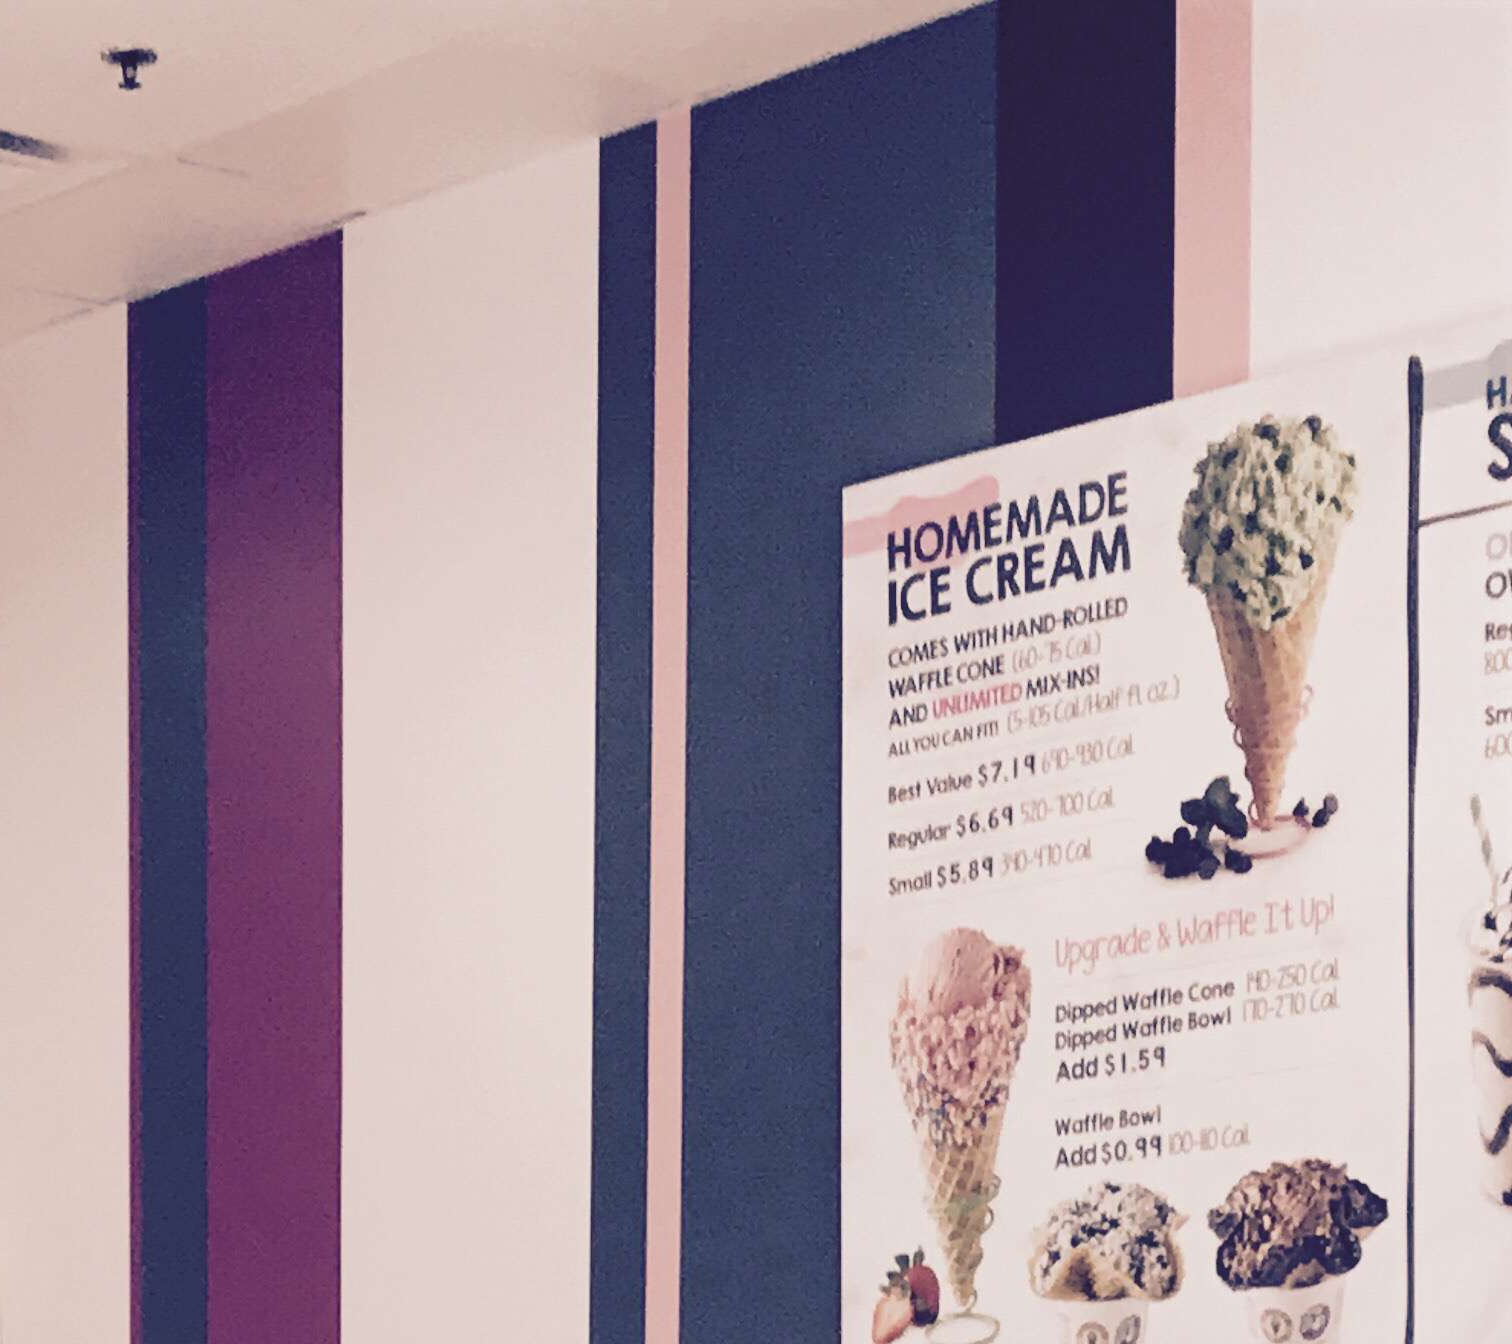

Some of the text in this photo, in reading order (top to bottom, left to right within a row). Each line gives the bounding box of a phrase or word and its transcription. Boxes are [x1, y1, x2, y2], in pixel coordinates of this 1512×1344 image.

[887, 471, 1128, 571] HOMEMADE
[888, 524, 1131, 626] ICE CREAM
[888, 597, 1129, 668] COMES WITH HAND-ROLLED
[888, 670, 952, 699] WAFFLE
[957, 655, 1005, 683] CONE
[888, 663, 1101, 729] AND UNLIMITED MIX-INS!
[888, 741, 910, 758] ALL
[913, 735, 938, 754] YOU
[942, 724, 973, 745] CAN
[888, 779, 921, 806] Best
[926, 770, 973, 797] Value
[978, 754, 1036, 790] $7.19
[1107, 732, 1134, 760] Cal
[888, 822, 952, 850] Regular
[956, 805, 1014, 838] $6.69
[1088, 785, 1114, 811] Cal
[888, 870, 932, 896] Small
[936, 855, 994, 889] $5.89
[1066, 836, 1092, 862] Cal
[1055, 894, 1335, 976] Upgrade & Waffle It Up!
[1055, 995, 1118, 1024] Dipped
[1122, 986, 1183, 1012] Waffle
[1188, 981, 1236, 1002] Cone
[1311, 958, 1339, 984] Cal
[1055, 1022, 1118, 1051] Dipped
[1122, 1012, 1183, 1039] Waffle
[1188, 1006, 1233, 1030] Bowl
[1310, 986, 1339, 1012] Cal
[1055, 1045, 1166, 1082] Add $1.59
[1055, 1105, 1162, 1137] Waffle Bowl
[1055, 1145, 1097, 1170] Add
[1101, 1134, 1163, 1166] $0.99
[1221, 1122, 1251, 1149] Cal
